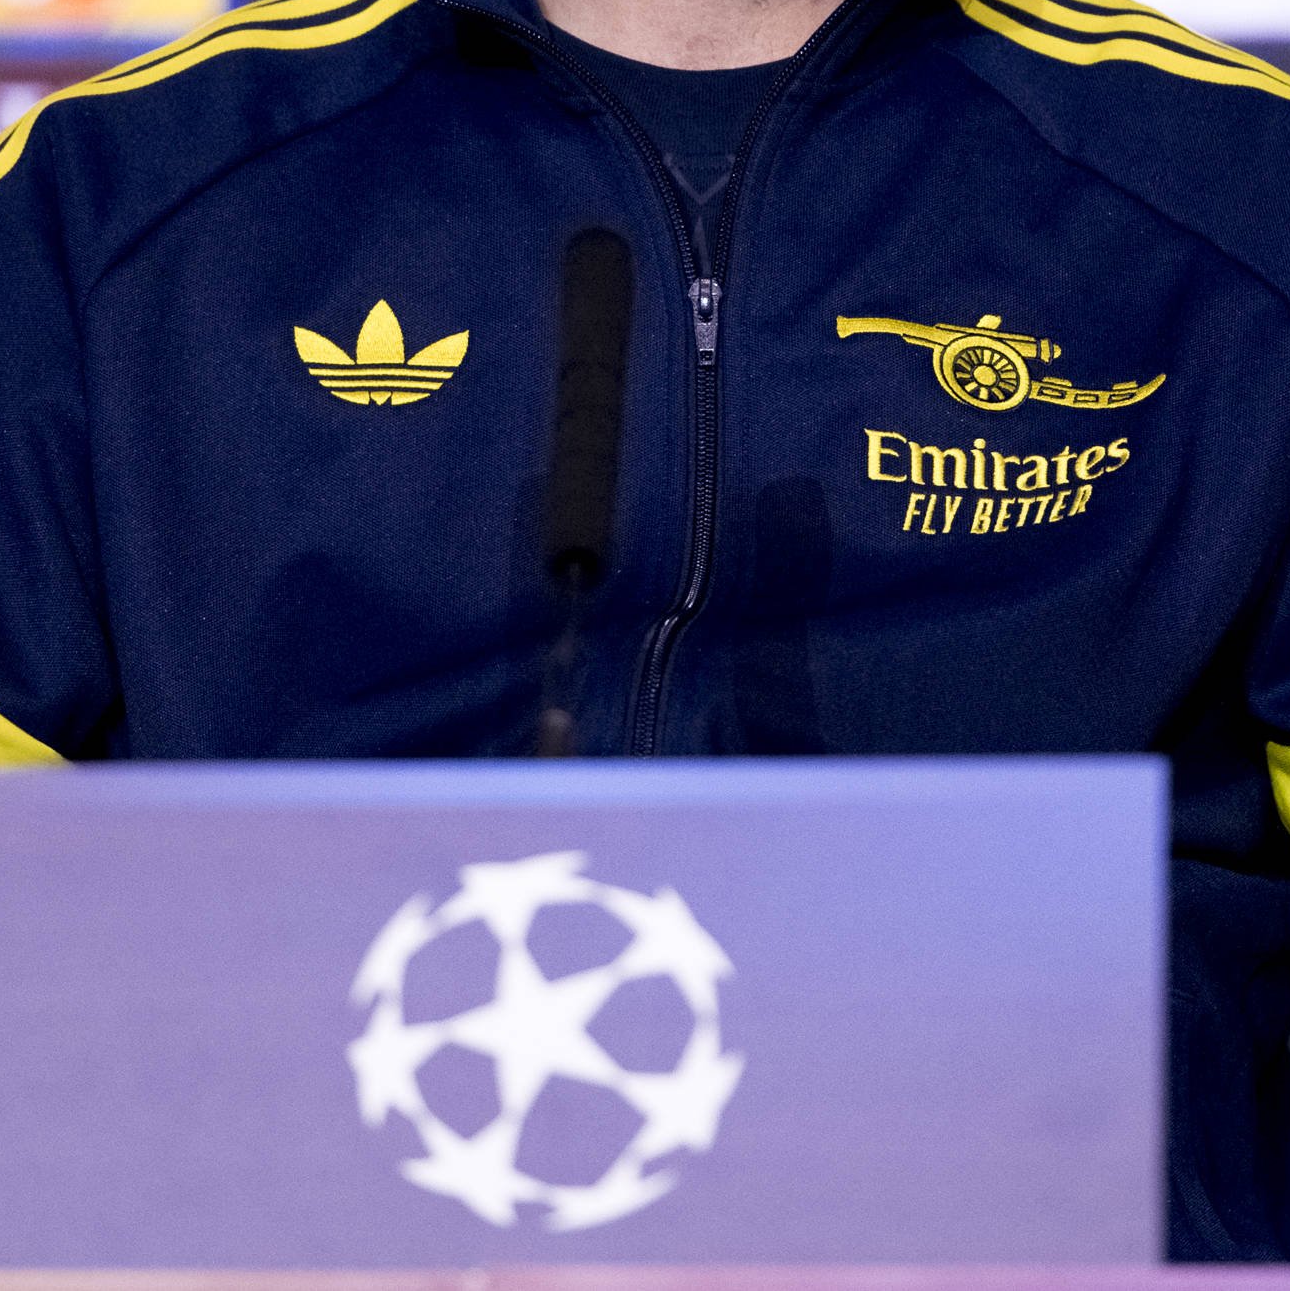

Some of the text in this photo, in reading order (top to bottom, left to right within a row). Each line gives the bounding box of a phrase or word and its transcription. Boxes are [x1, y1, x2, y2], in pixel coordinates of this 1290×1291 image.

[864, 428, 1131, 491] Emirates
[902, 484, 1094, 535] FLY BETTER
